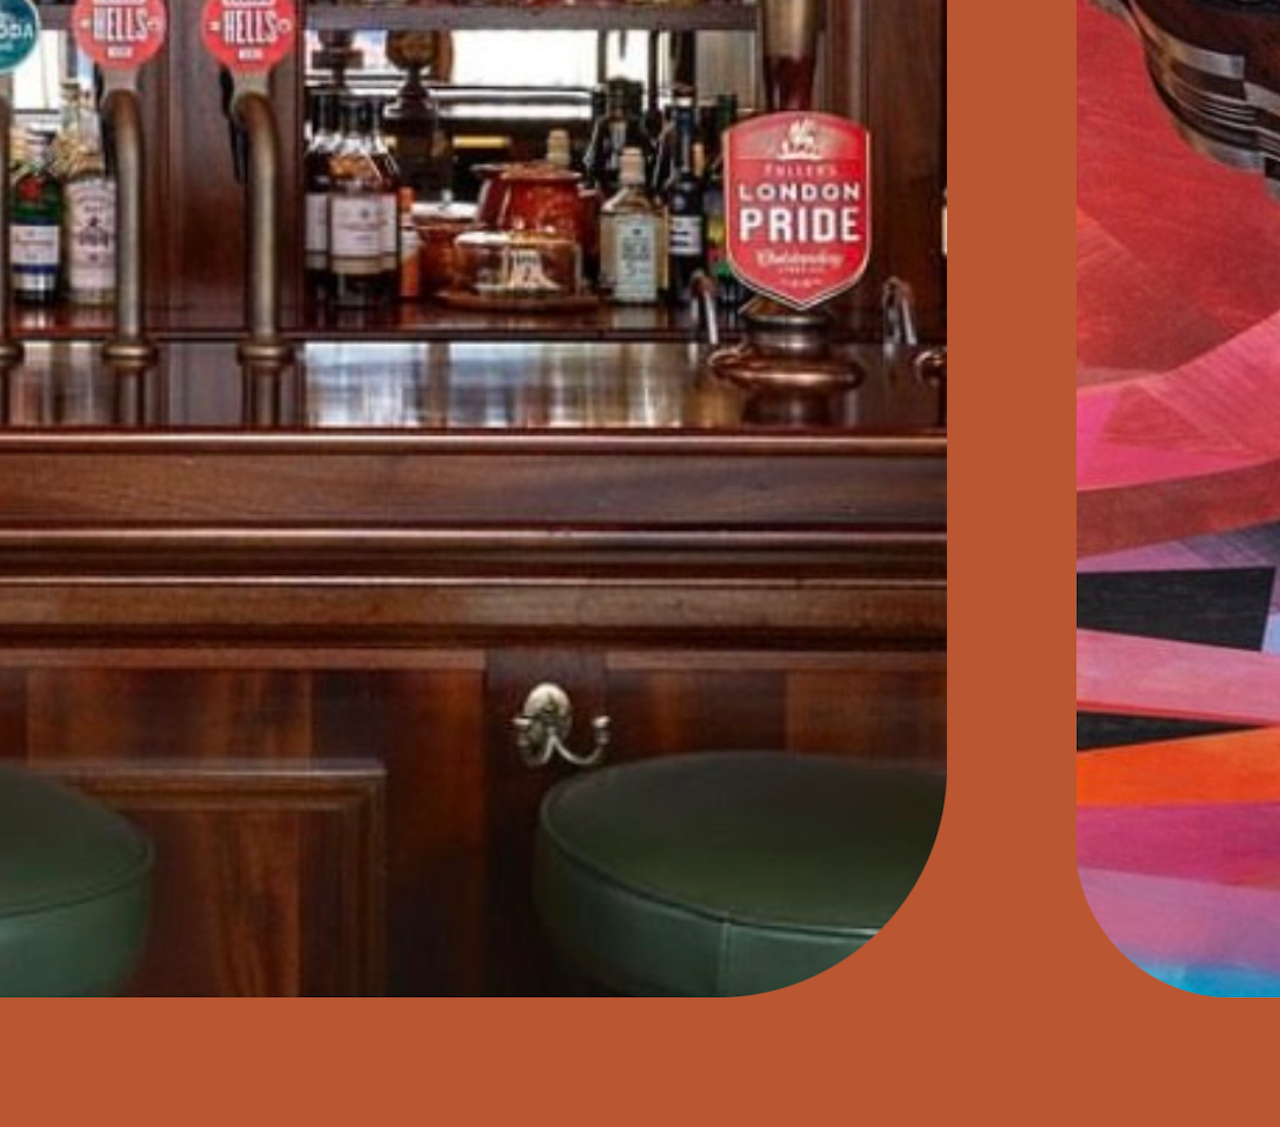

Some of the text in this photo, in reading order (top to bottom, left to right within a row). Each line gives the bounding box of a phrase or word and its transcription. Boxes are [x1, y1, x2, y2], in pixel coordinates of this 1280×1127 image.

[93, 7, 148, 41] HELLS
[223, 10, 278, 44] HELLS
[739, 182, 860, 202] LONDON
[739, 207, 861, 242] PRIDE
